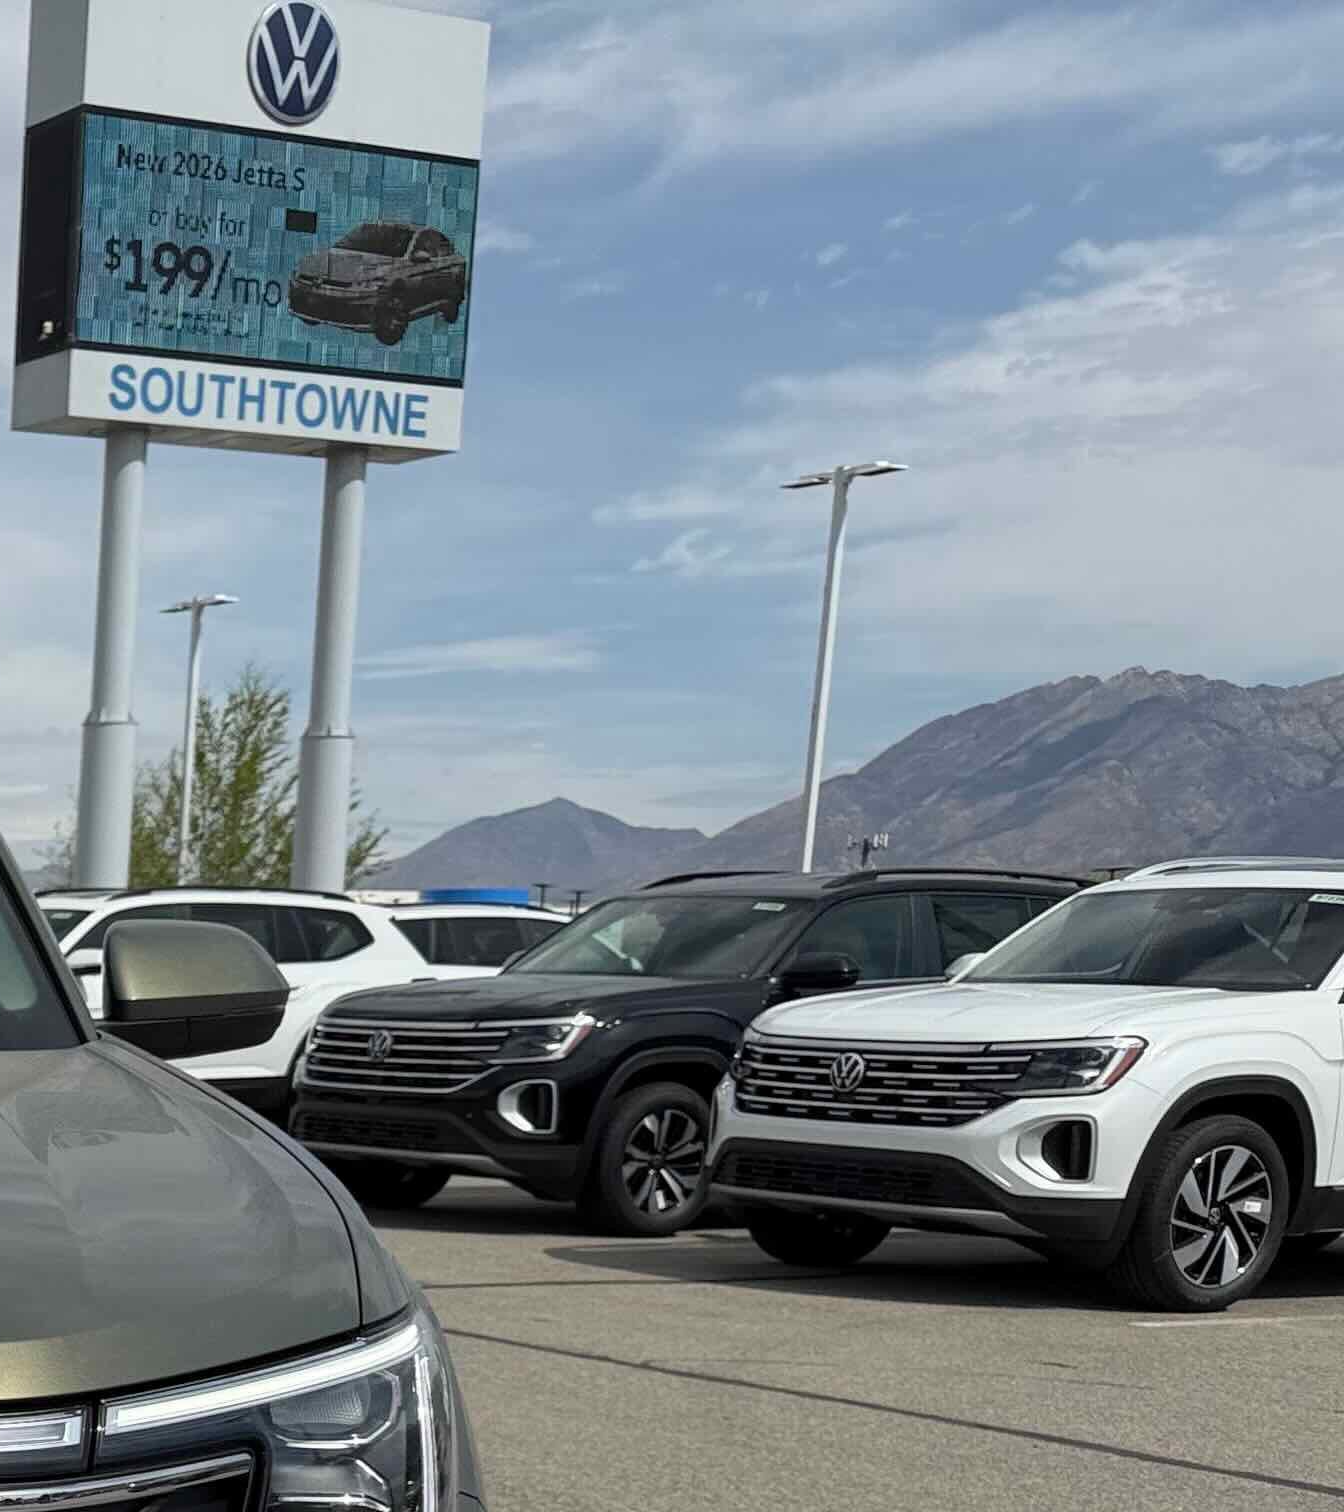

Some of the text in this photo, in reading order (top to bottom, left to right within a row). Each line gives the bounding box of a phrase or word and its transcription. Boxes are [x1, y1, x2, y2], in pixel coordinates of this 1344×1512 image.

[117, 143, 306, 192] New 2026 Jetta S
[220, 211, 245, 236] for
[104, 234, 282, 308] $199/mo
[108, 364, 429, 439] SOUTHTOWNE
